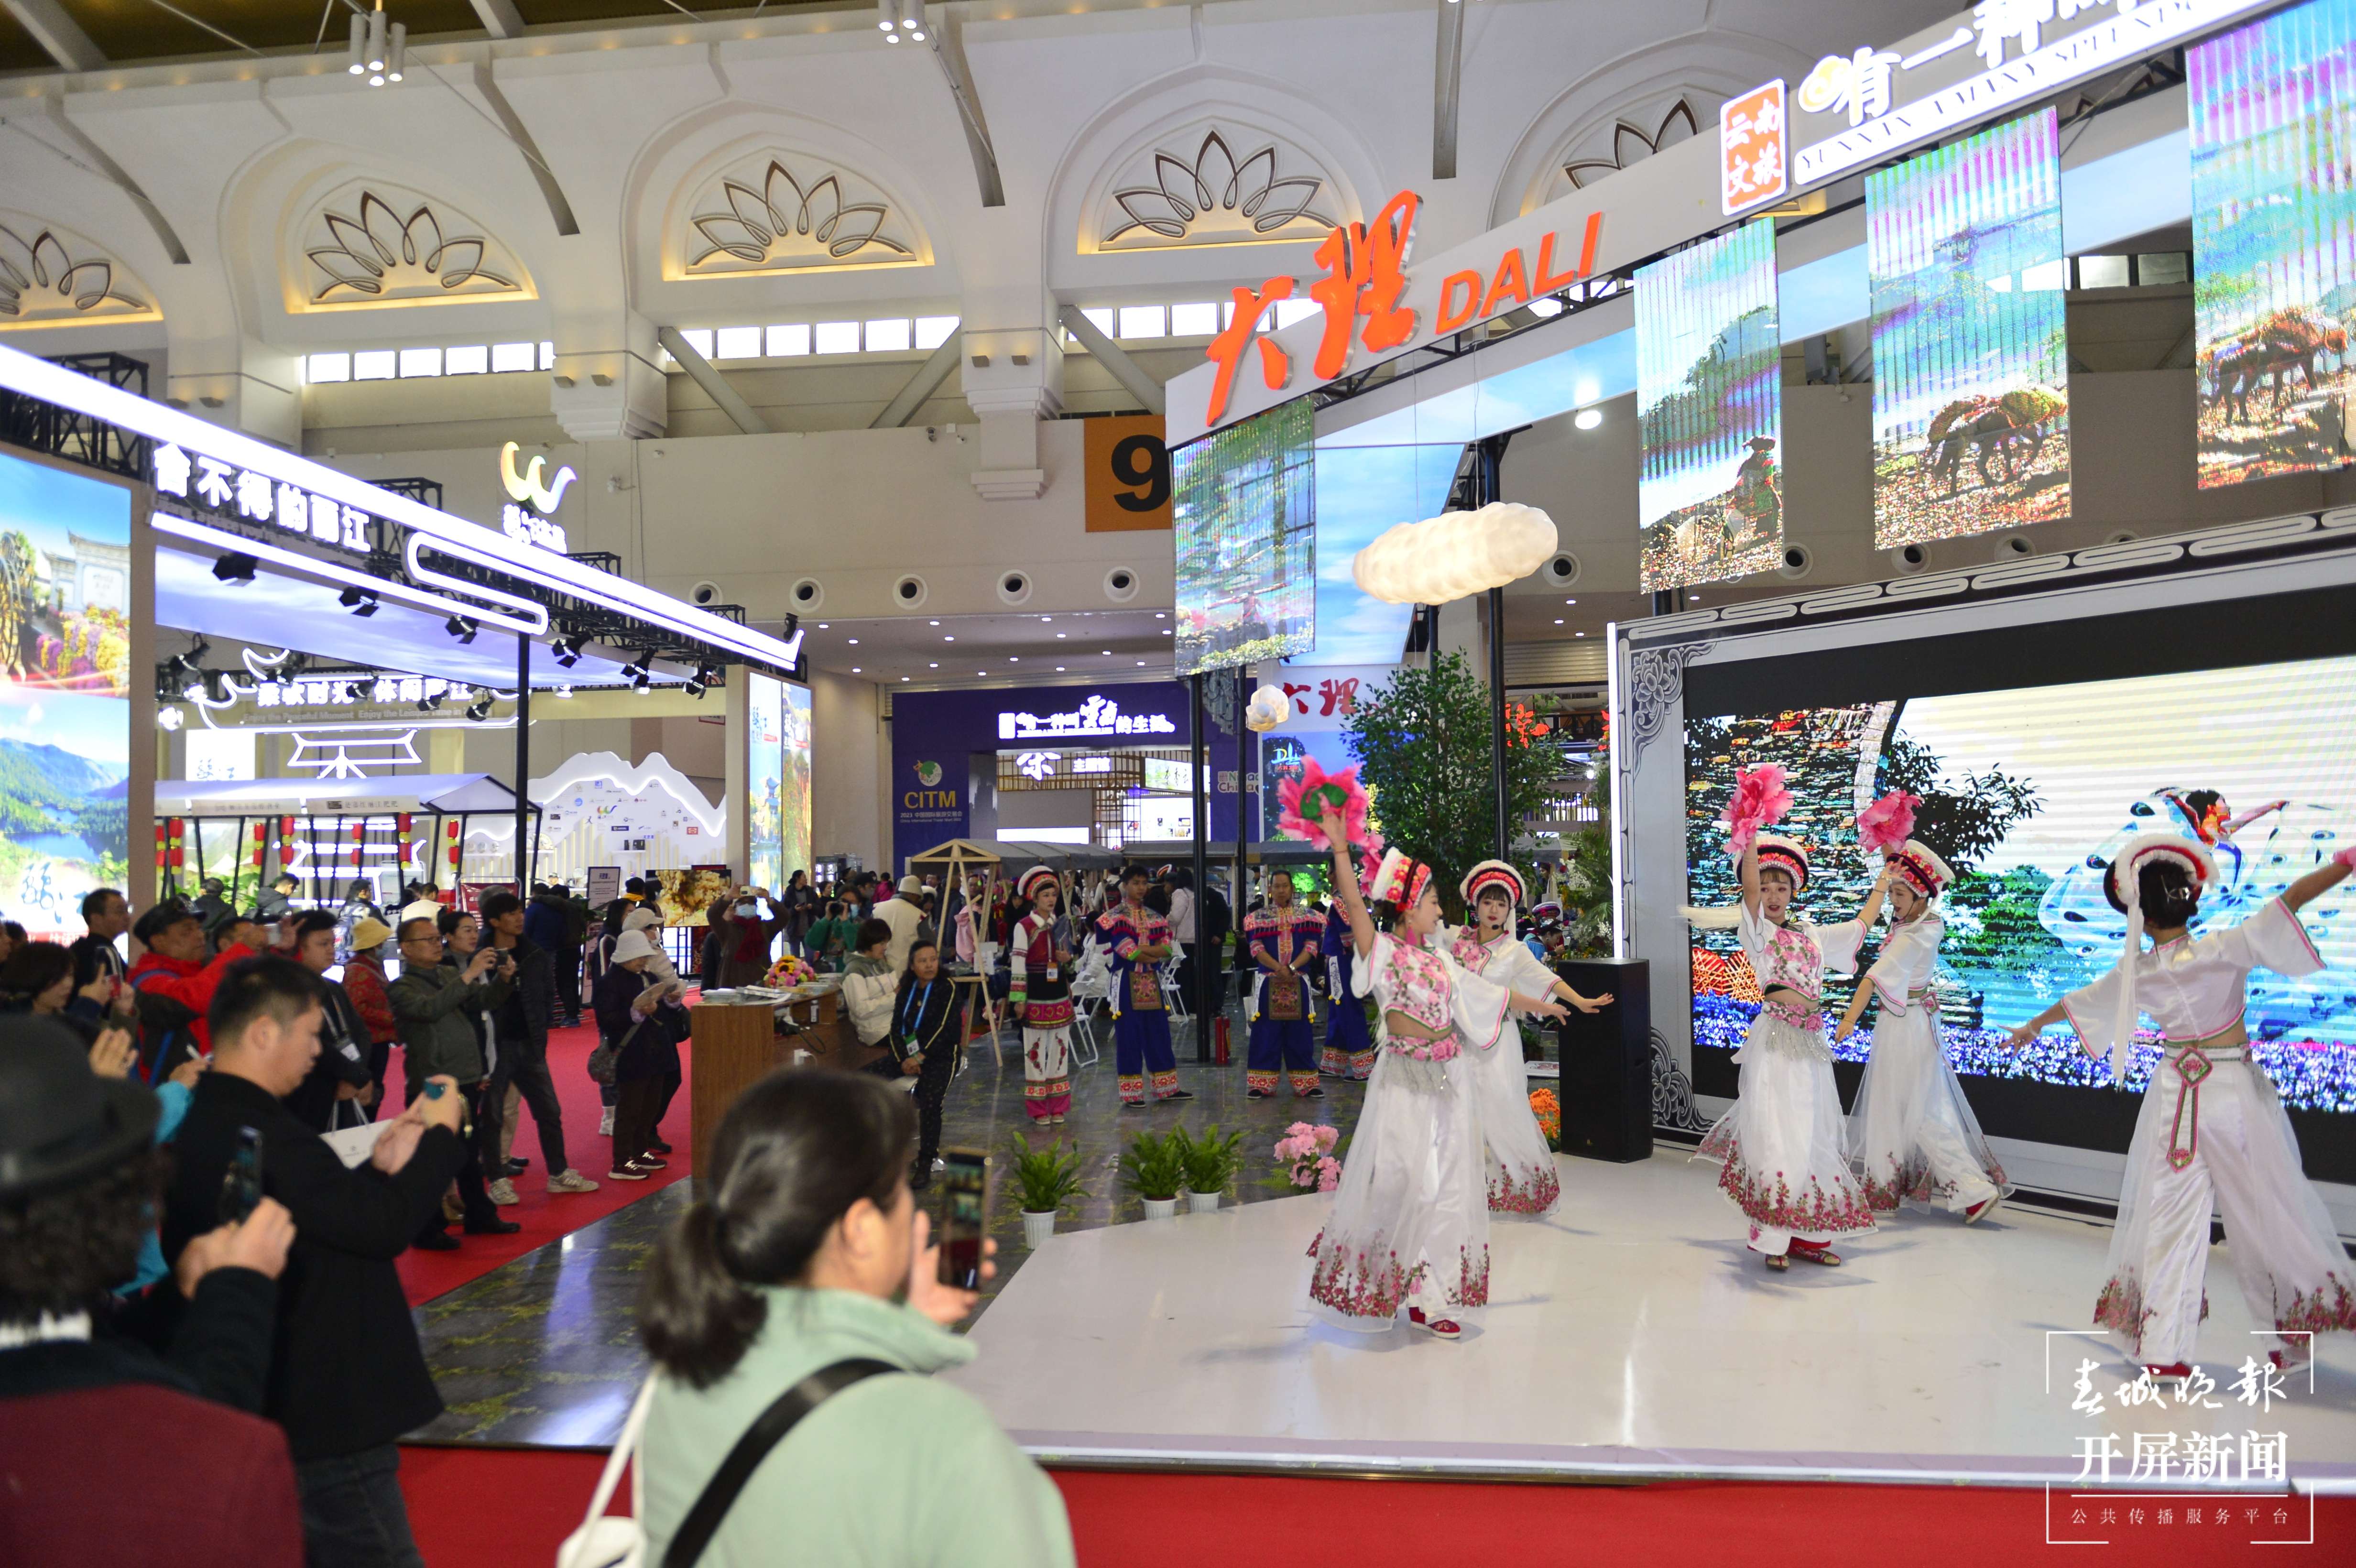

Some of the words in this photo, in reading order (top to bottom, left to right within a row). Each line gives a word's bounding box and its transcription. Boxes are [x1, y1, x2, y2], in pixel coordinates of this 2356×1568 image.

[1726, 98, 1780, 150] 云南
[1728, 141, 1782, 198] 文旅
[1435, 211, 1603, 335] DALI
[1206, 189, 1422, 427] 大理
[1111, 434, 1171, 512] 9
[904, 790, 956, 809] CITM
[1219, 782, 1254, 792] Chia
